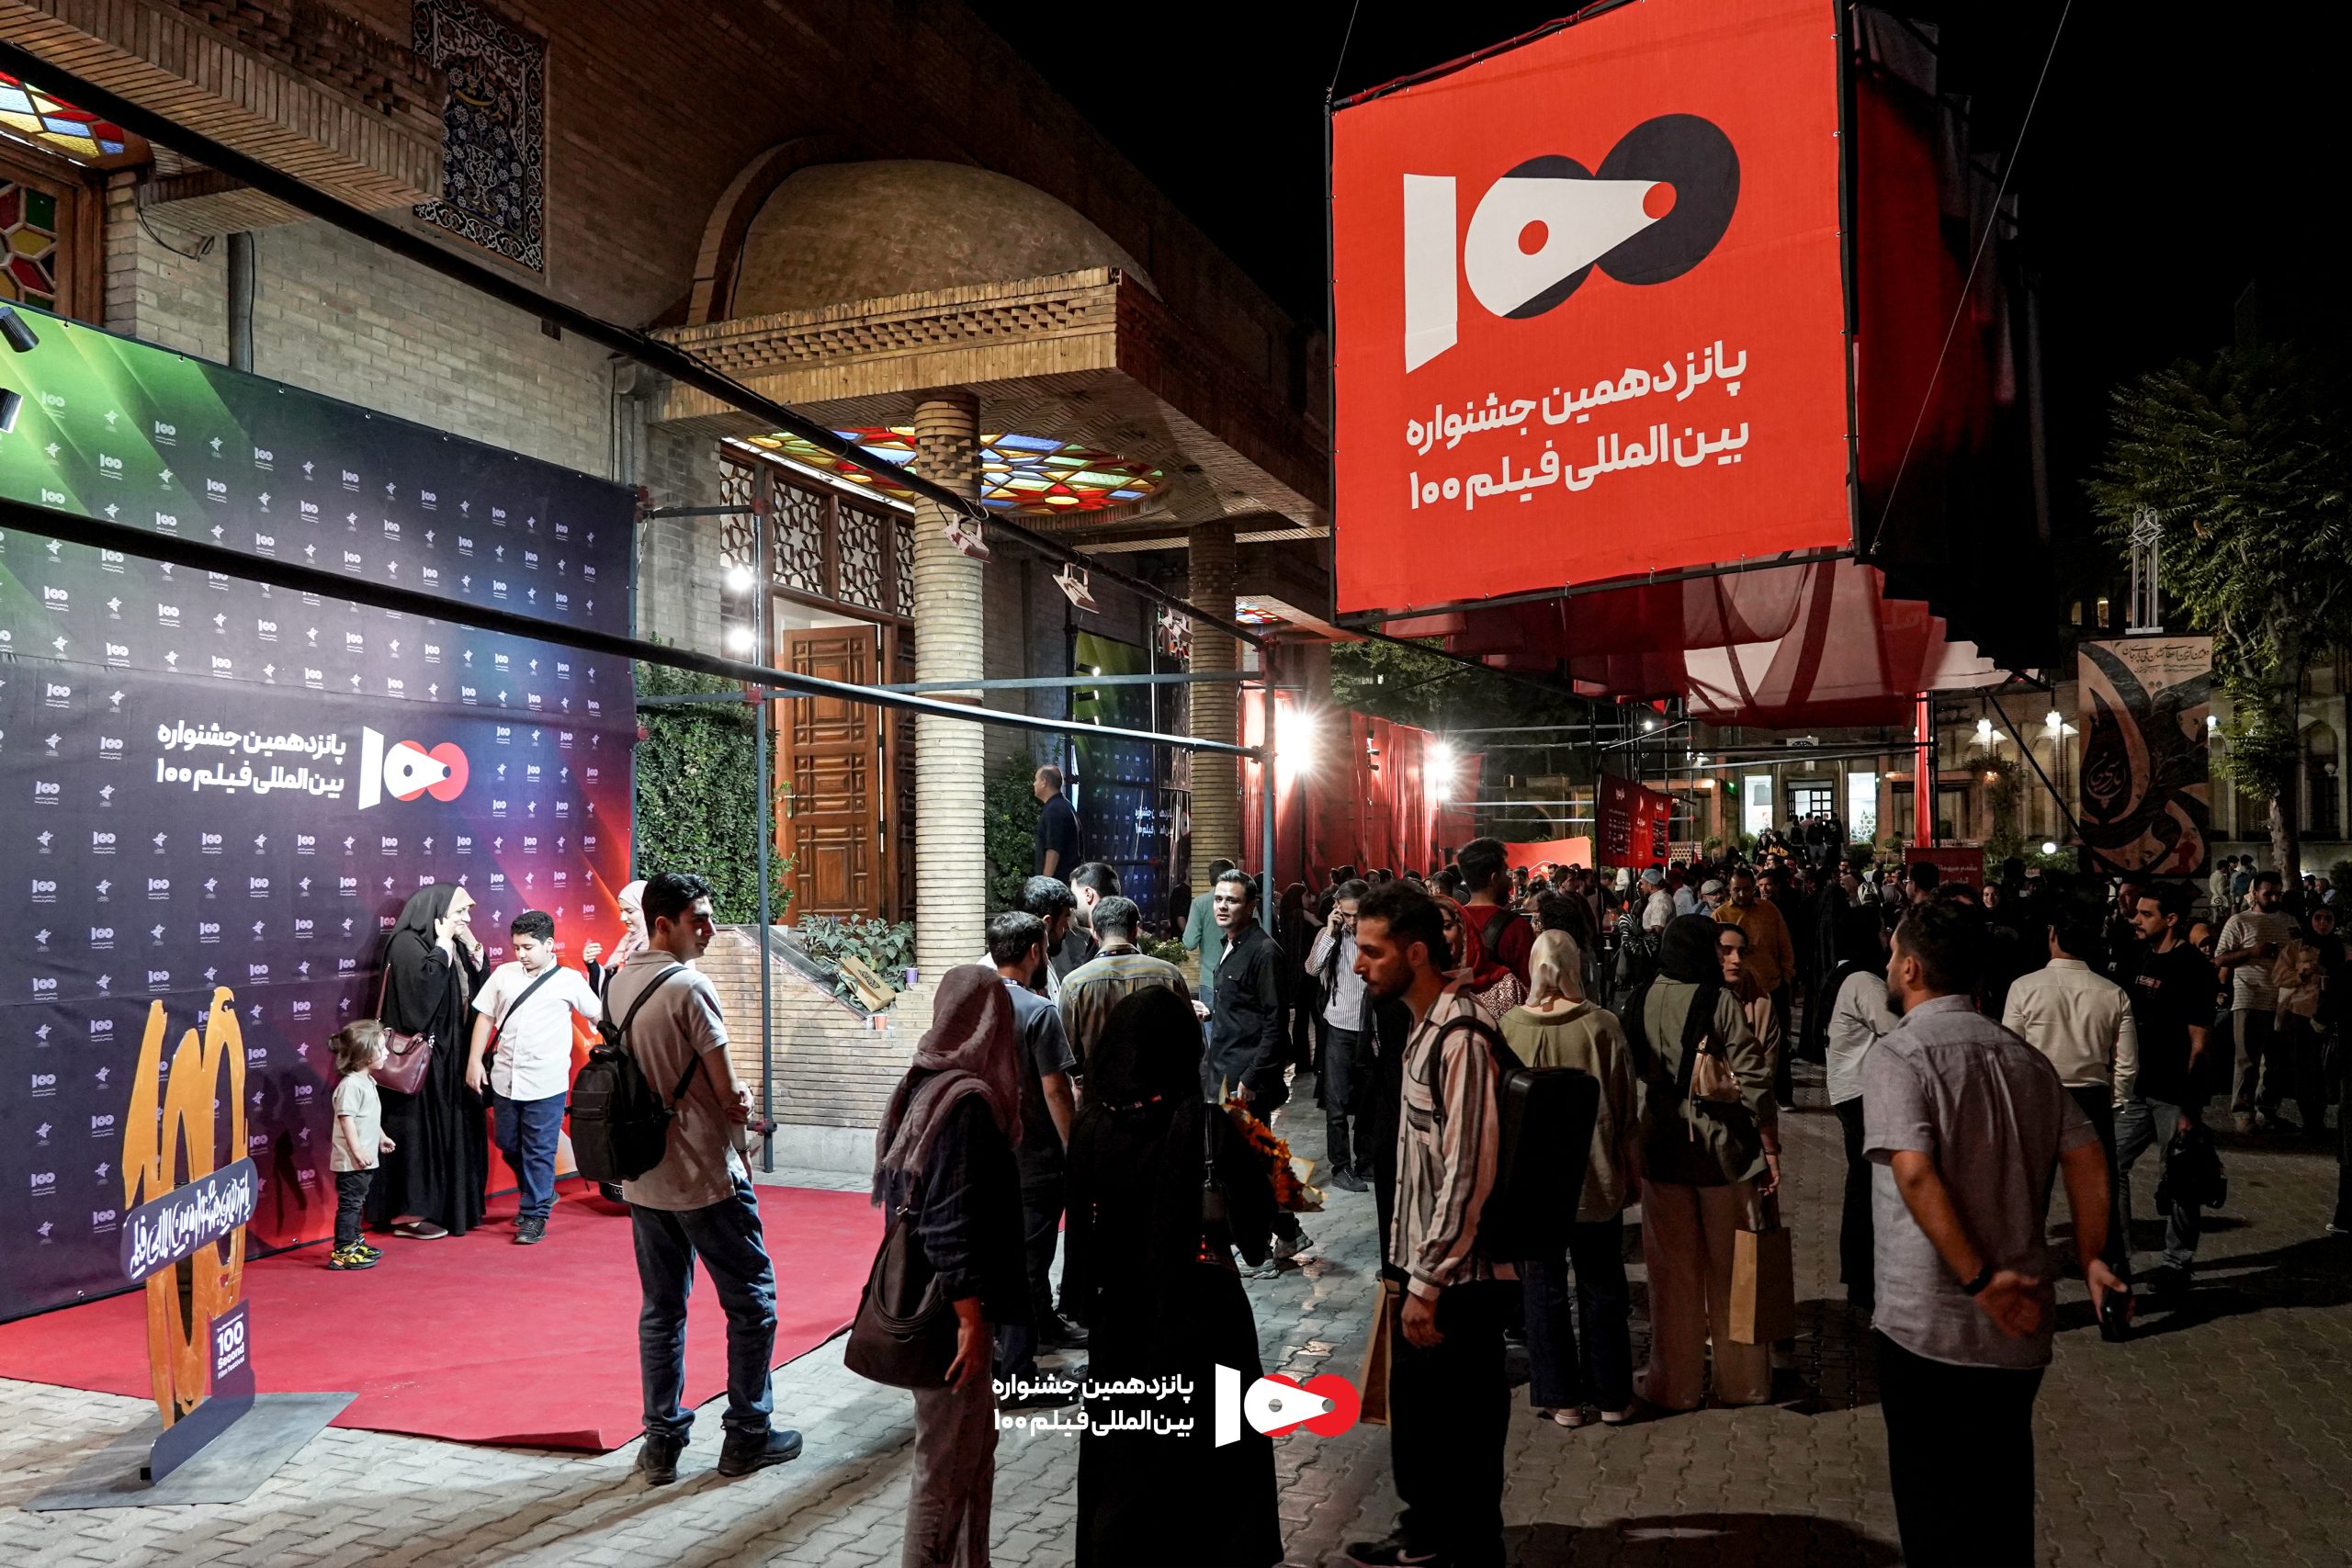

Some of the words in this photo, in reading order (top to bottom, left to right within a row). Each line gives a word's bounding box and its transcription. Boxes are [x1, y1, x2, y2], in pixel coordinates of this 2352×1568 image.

[1542, 340, 1747, 426] پانزدهمین
[1406, 391, 1537, 456] جشنواره
[1465, 439, 1560, 511] فیلم
[157, 719, 243, 754] جشنواره
[243, 731, 346, 764] پانزدهمین
[193, 760, 253, 794] فیلم
[217, 1321, 244, 1356] 100
[217, 1341, 245, 1370] Second
